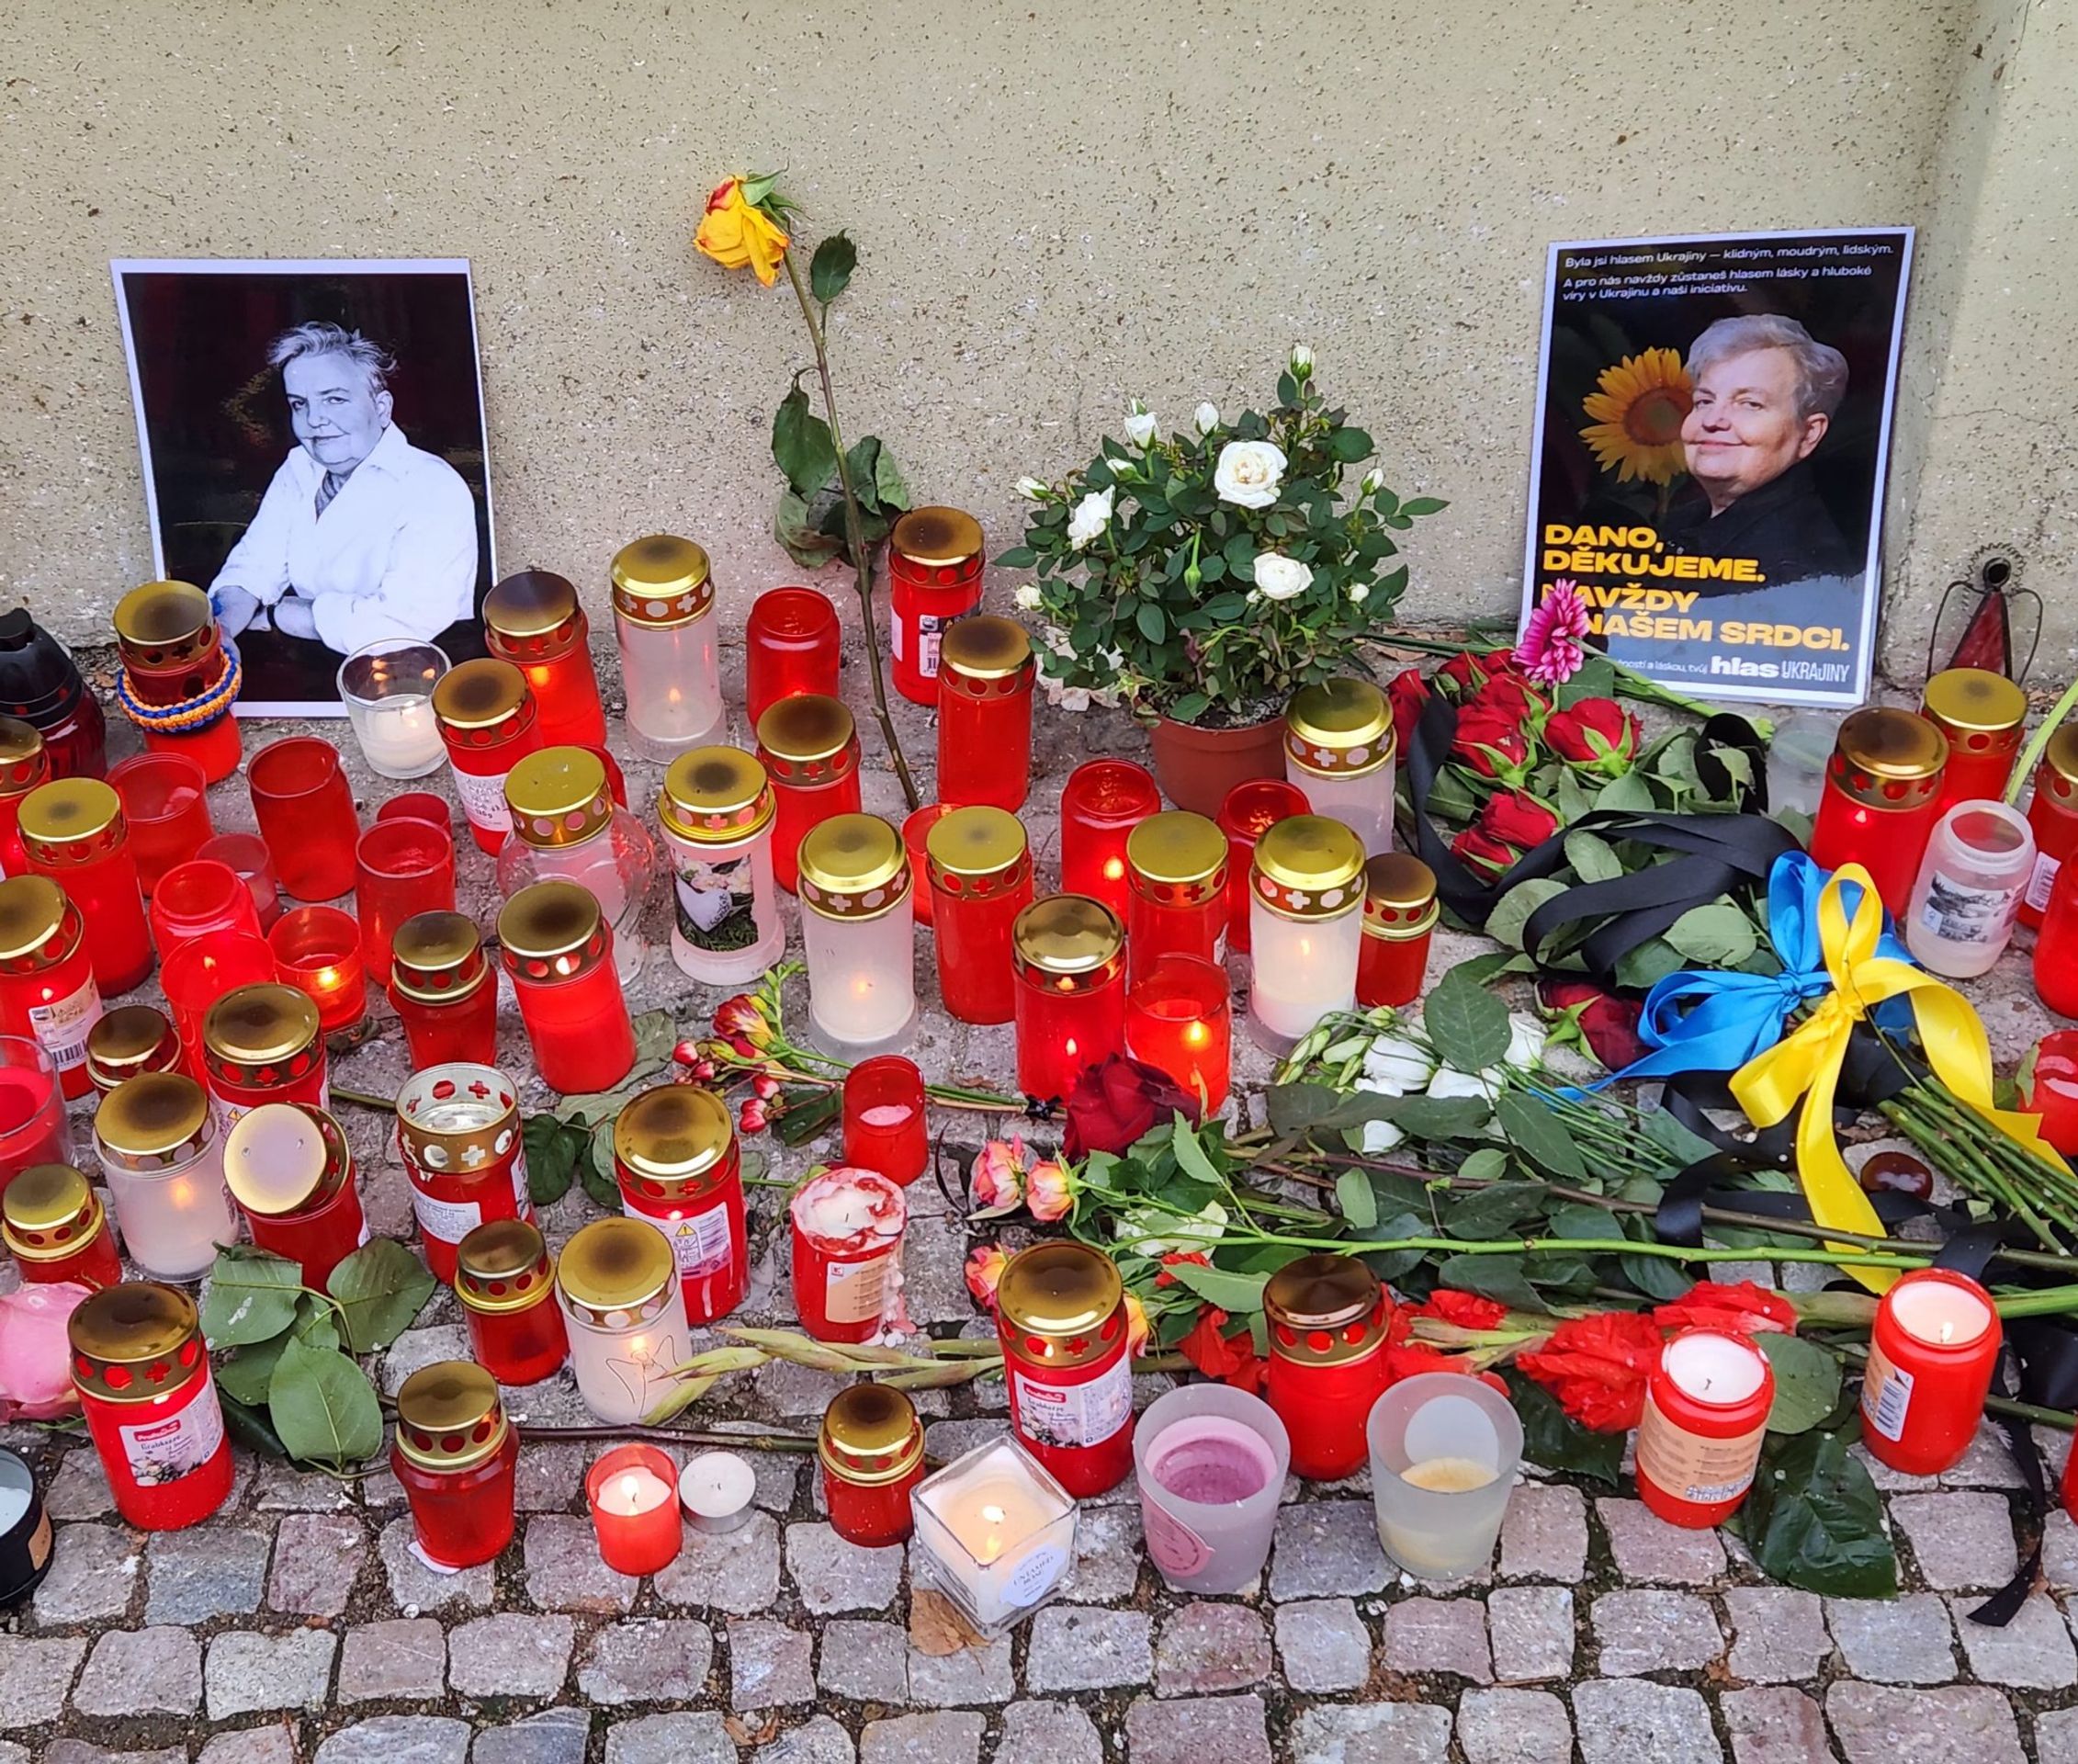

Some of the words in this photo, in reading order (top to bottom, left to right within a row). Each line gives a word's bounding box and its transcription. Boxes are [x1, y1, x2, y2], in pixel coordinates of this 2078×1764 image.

[1564, 257, 1592, 269] Byla
[1593, 255, 1608, 267] jsi
[1609, 254, 1654, 266] hlasem
[1656, 251, 1707, 264] Ukrajiny
[1723, 248, 1774, 260] klidným,
[1777, 245, 1839, 258] moudrým,
[1842, 244, 1894, 255] lidským.
[1564, 278, 1573, 288] A
[1575, 278, 1596, 289] pro
[1598, 276, 1622, 286] nás
[1624, 273, 1667, 286] navždy
[1670, 270, 1727, 282] zůstaneš
[1729, 269, 1773, 279] hlasem
[1776, 267, 1809, 279] lásky
[1811, 268, 1819, 277] a
[1822, 266, 1872, 277] hluboké
[1563, 289, 1586, 301] víry
[1599, 288, 1649, 300] Ukrajinu
[1652, 288, 1660, 296] a
[1662, 286, 1688, 295] naši
[1690, 283, 1748, 294] iniciativu.
[1544, 524, 1665, 553] DANO,
[1542, 546, 1766, 582] DĚKUJEME.
[1720, 621, 1850, 651] SRDCI.
[1711, 655, 1779, 678] hlas
